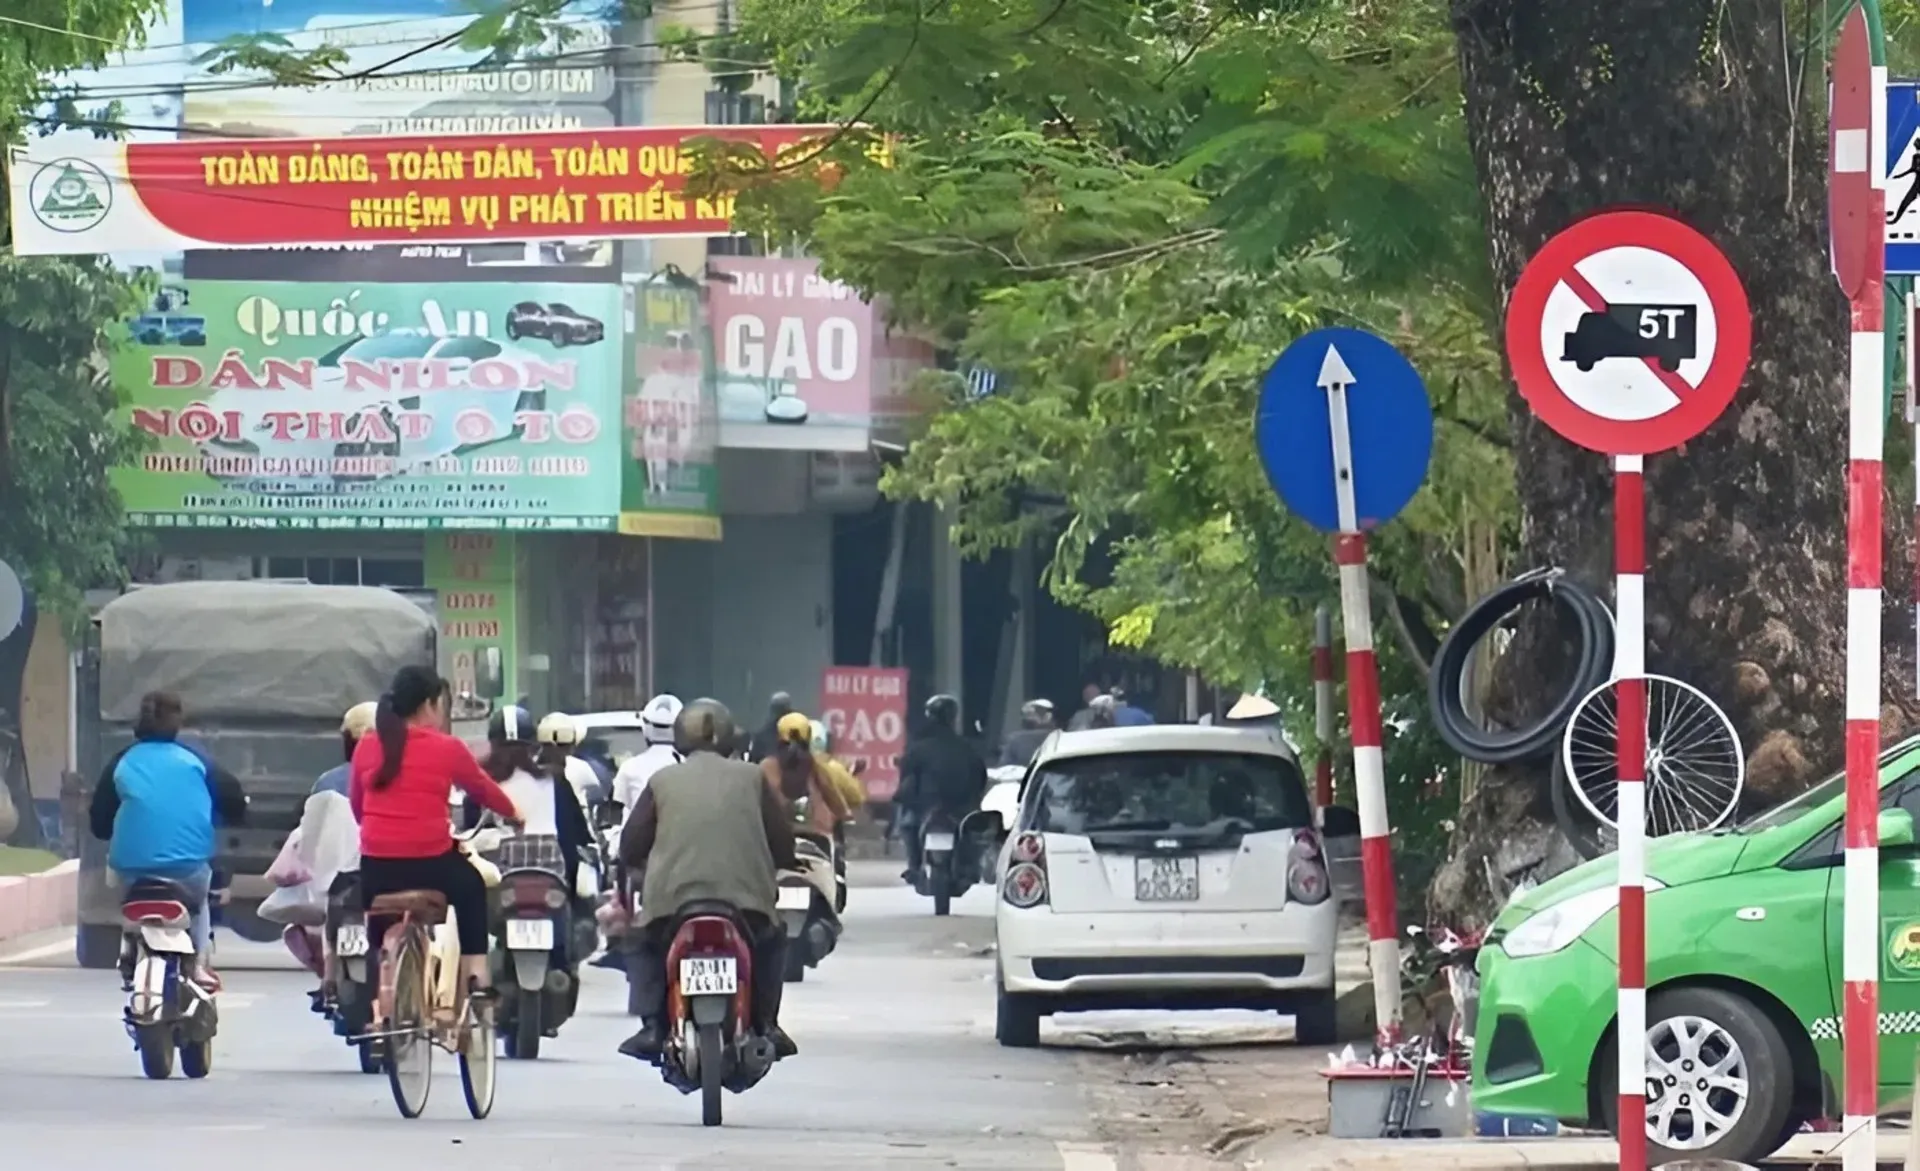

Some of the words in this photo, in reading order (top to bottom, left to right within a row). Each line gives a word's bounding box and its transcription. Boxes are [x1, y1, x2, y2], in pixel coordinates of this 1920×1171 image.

[201, 149, 280, 186] TOÀN
[387, 144, 464, 181] TOÀN
[551, 140, 630, 177] TOÀN
[350, 191, 451, 233] NHIỆM
[460, 195, 499, 231] VỤ
[509, 184, 588, 223] PHÁT
[600, 180, 686, 222] TRIỂN
[237, 289, 389, 346] Quốc
[1638, 308, 1685, 339] 5T
[133, 401, 243, 447] NỘI
[822, 708, 902, 749] GẠO
